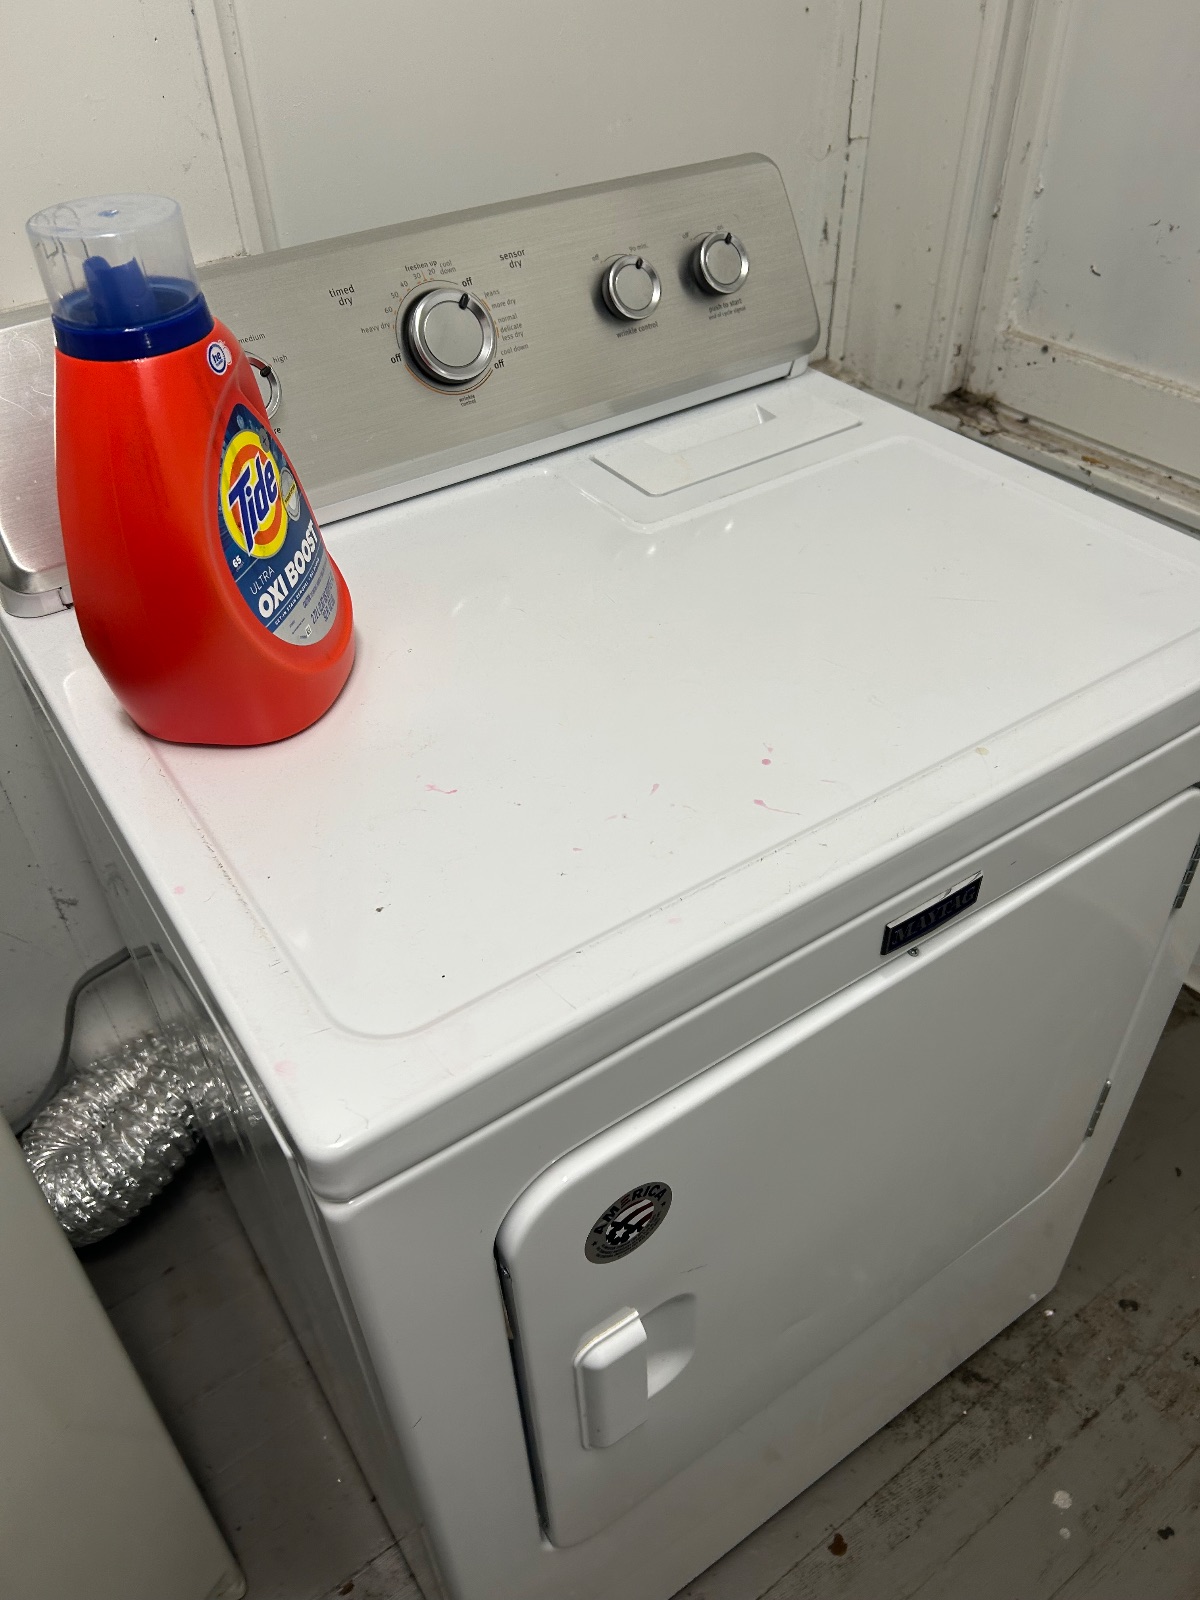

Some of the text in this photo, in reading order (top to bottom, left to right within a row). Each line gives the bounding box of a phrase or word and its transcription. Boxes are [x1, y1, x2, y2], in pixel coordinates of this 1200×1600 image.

[499, 249, 525, 261] sensor
[405, 260, 437, 272] freshen up
[440, 259, 452, 268] cool
[509, 259, 522, 269] dry
[428, 268, 436, 276] 20
[440, 267, 456, 275] down
[461, 277, 473, 287] off
[329, 284, 355, 298] timed
[391, 291, 399, 299] 50
[484, 290, 500, 298] jeans
[338, 297, 353, 306] dry
[491, 301, 506, 309] more
[384, 306, 393, 314] 60
[497, 313, 517, 323] normal
[361, 322, 390, 334] heavy dry
[500, 323, 522, 333] delicate
[616, 320, 659, 338] wrinkle control
[238, 333, 266, 343] medium
[501, 343, 529, 356] cool down
[212, 352, 222, 363] he
[273, 354, 288, 363] high
[390, 353, 402, 364] off
[494, 359, 505, 369] off
[228, 450, 279, 557] Tide
[232, 555, 242, 568] 65
[258, 573, 289, 618] OXI
[284, 519, 318, 588] BOOST
[249, 566, 275, 595] ULTRA
[593, 1184, 668, 1235] AMERICA
